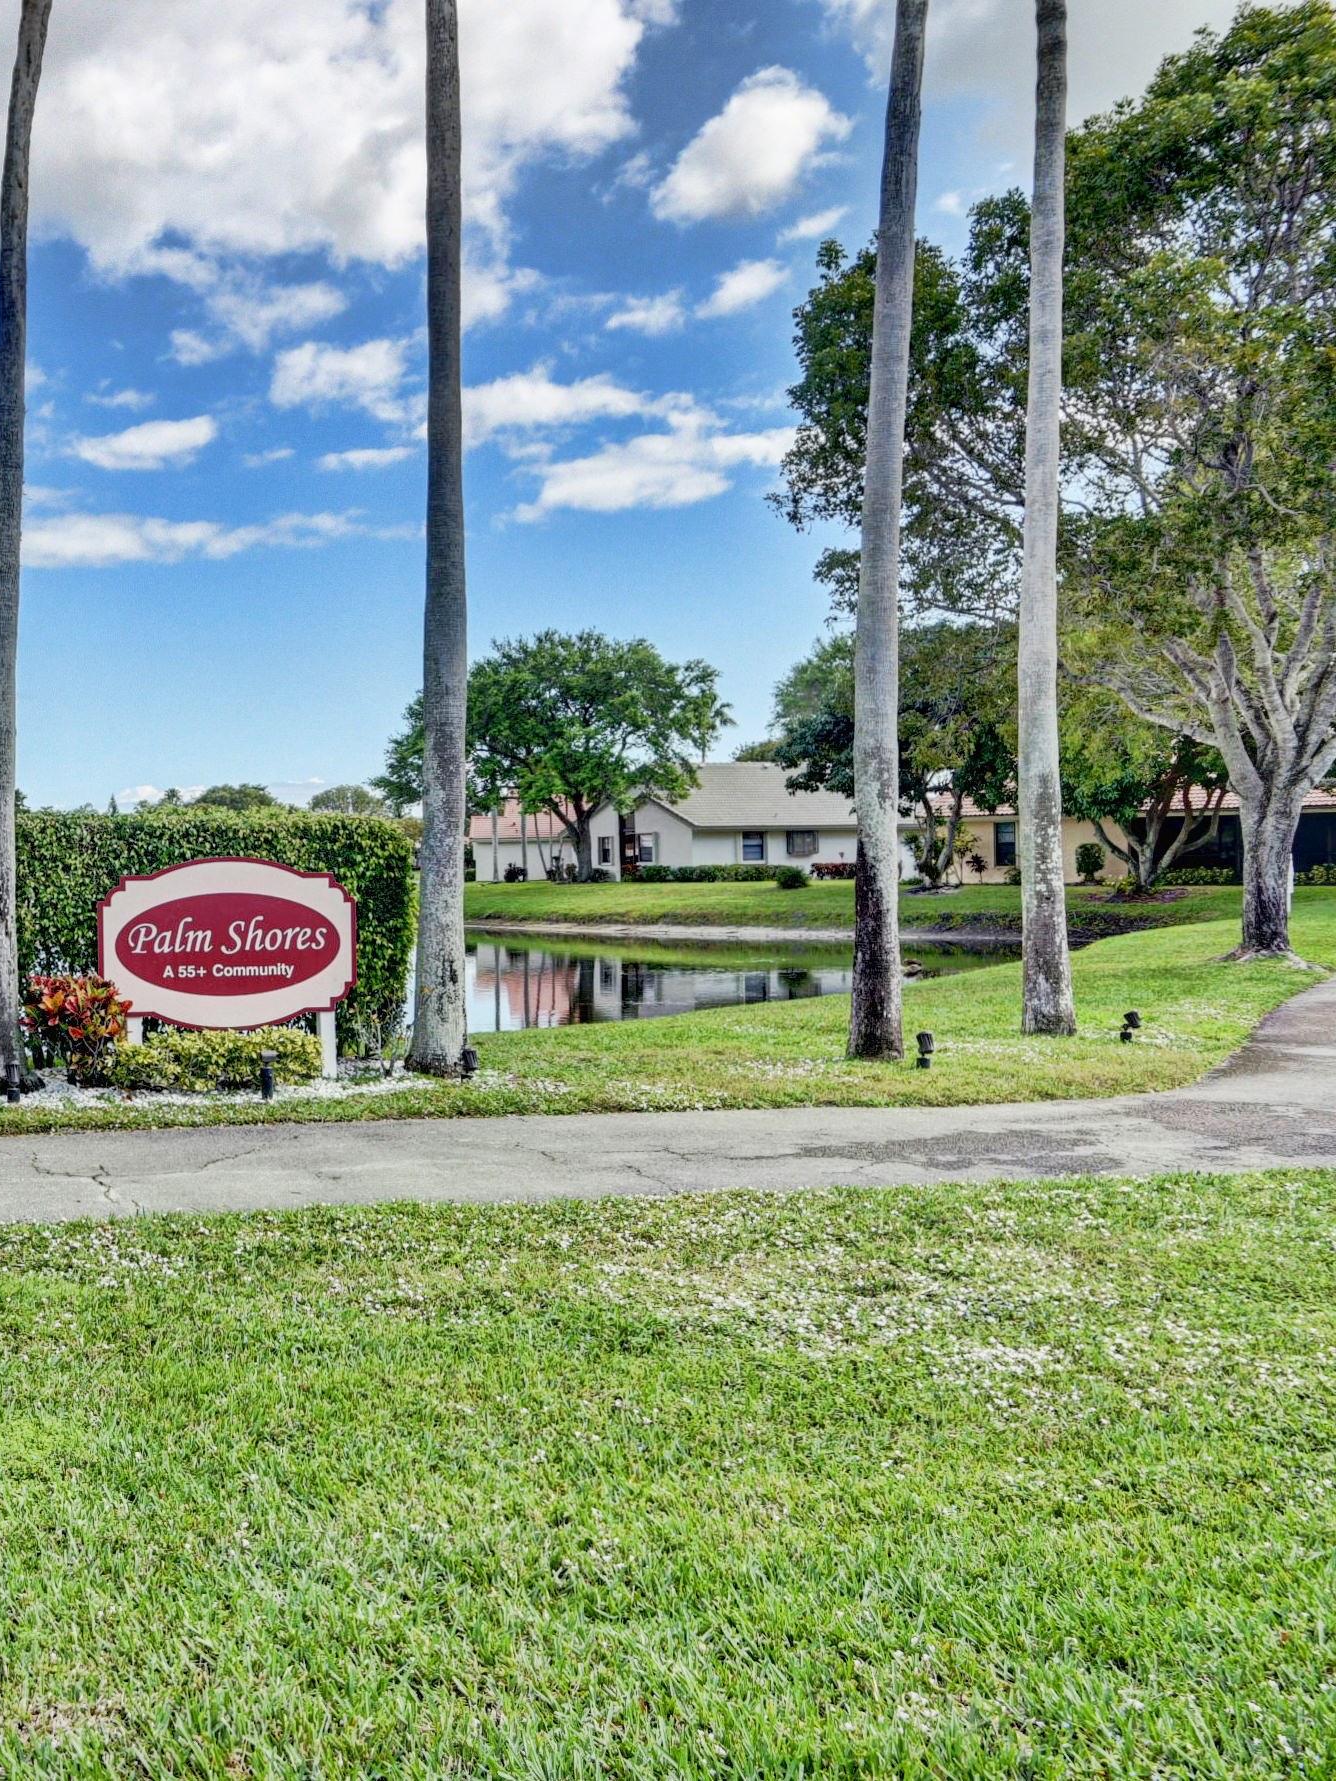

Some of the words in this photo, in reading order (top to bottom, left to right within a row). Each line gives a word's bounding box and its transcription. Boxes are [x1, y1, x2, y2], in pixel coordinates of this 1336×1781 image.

[128, 917, 213, 954] Palm
[221, 915, 327, 954] Shores
[163, 965, 174, 978] A
[178, 965, 207, 978] 55+
[212, 963, 294, 978] Community
